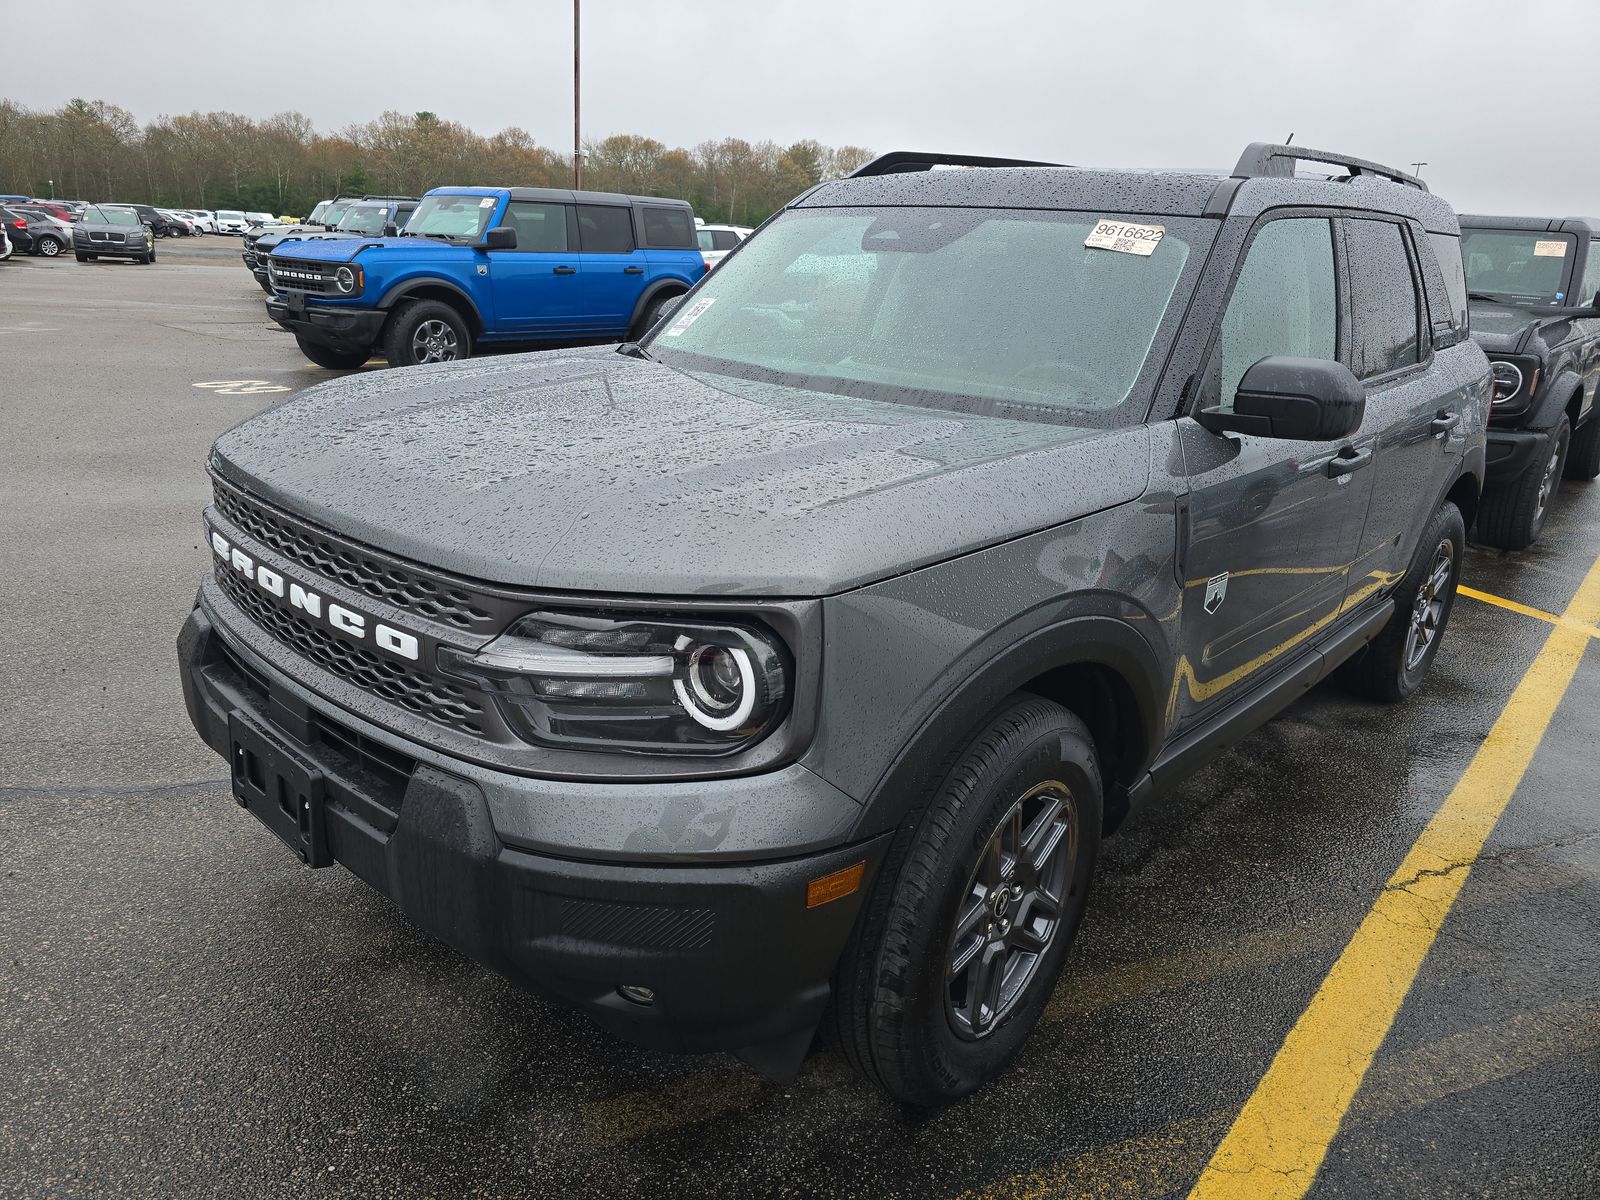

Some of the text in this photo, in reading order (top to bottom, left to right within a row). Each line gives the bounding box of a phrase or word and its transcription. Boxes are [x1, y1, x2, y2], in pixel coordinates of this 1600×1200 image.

[1096, 224, 1164, 242] 9616622
[276, 270, 322, 281] BRONCO
[212, 532, 419, 661] BRONCO
